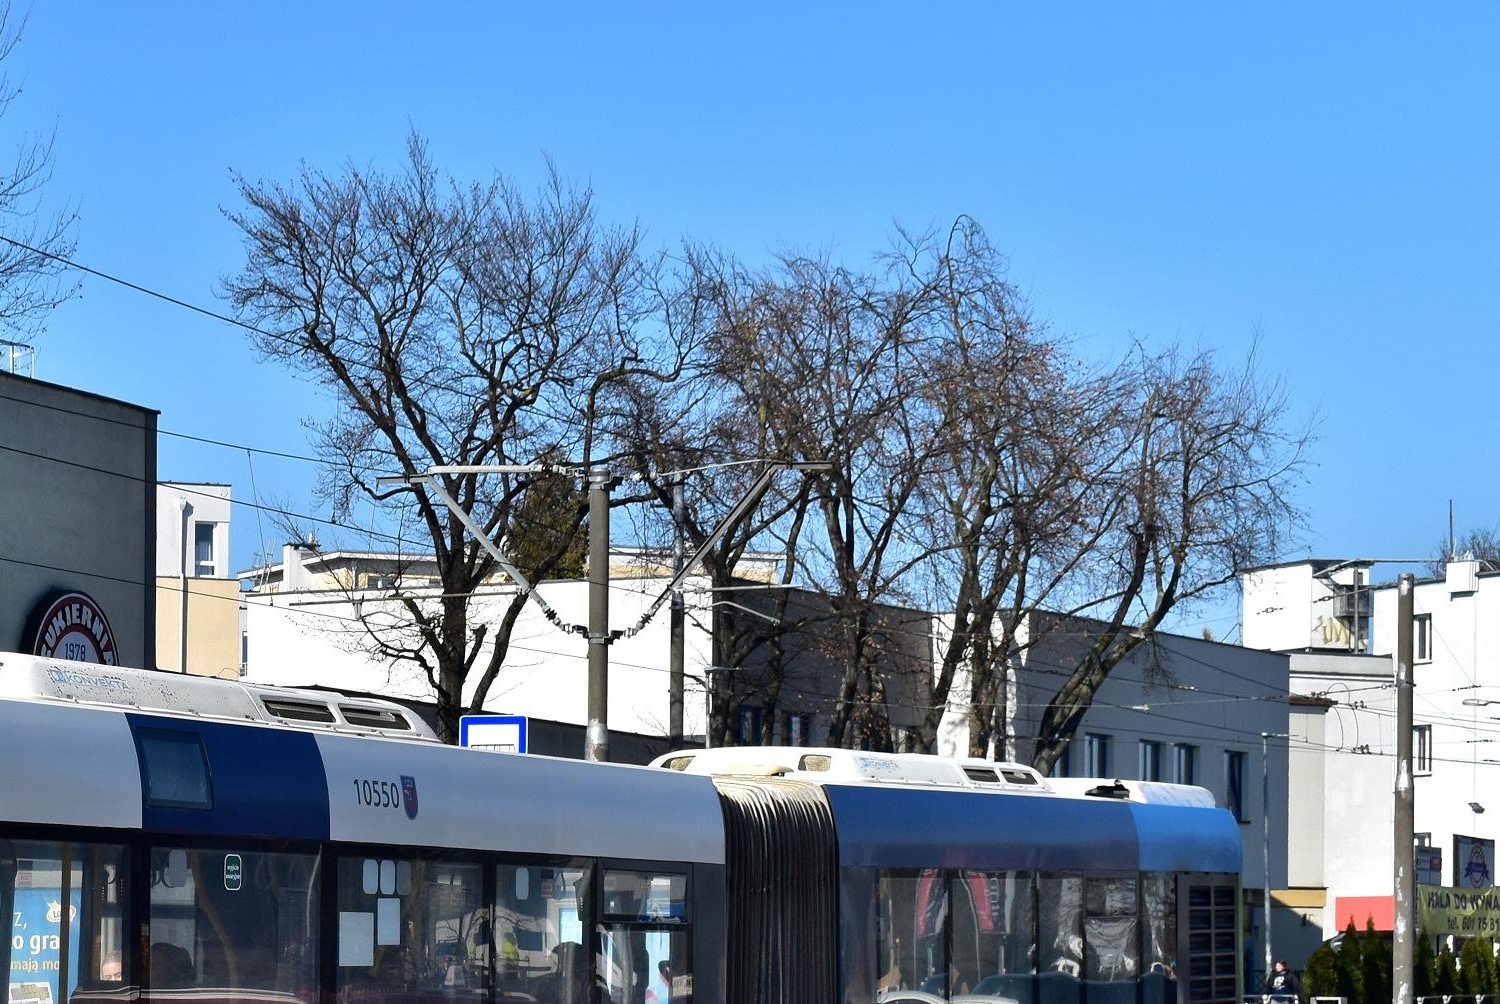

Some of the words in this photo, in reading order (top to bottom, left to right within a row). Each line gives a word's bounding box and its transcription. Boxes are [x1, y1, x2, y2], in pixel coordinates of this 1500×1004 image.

[65, 643, 86, 661] 1978
[67, 674, 131, 692] KONVEKTA
[353, 779, 400, 808] 10550
[1454, 893, 1467, 910] DO
